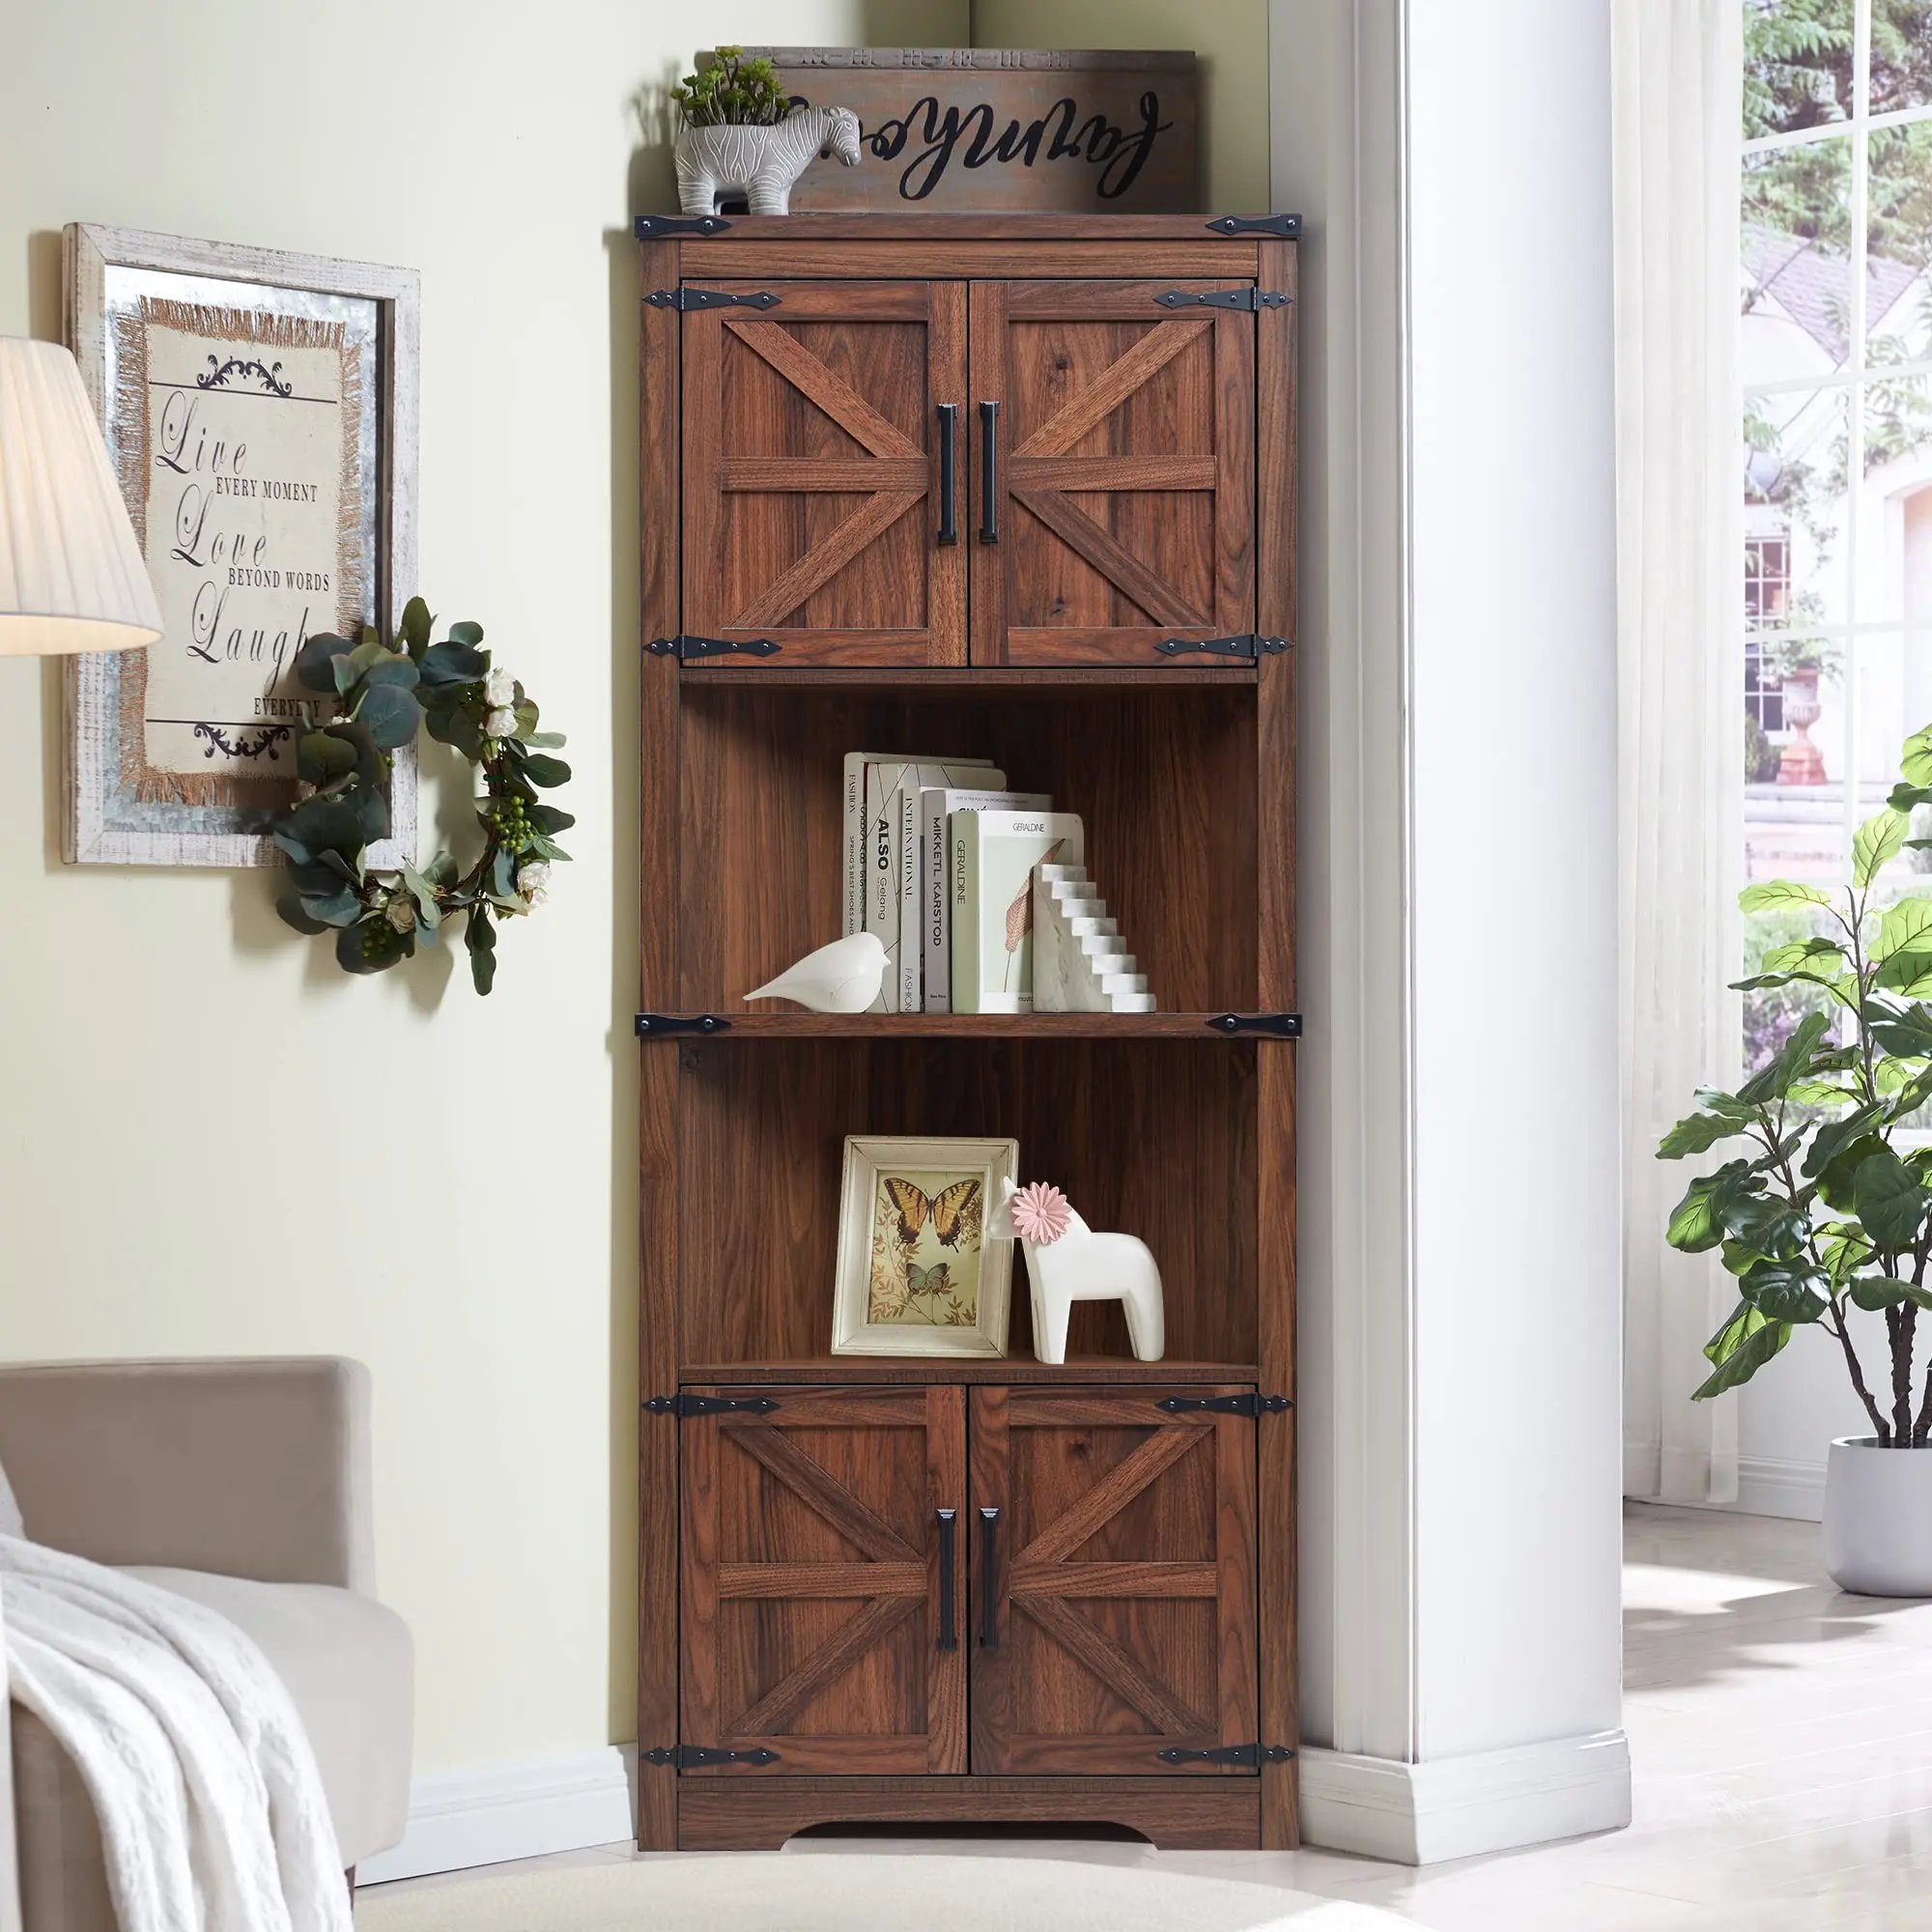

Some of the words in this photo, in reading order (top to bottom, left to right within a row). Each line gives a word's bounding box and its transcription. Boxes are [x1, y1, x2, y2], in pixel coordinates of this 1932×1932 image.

[857, 91, 1174, 200] farmho
[155, 390, 248, 474] Live
[215, 476, 258, 497] EVERY
[262, 481, 318, 502] MOMENT
[170, 483, 267, 567] Love
[228, 567, 281, 588] BEYOND
[285, 571, 330, 592] WORDS
[848, 774, 857, 813] FASHION
[877, 818, 890, 870] ALSO
[904, 798, 913, 900] INTERNATIONAL
[932, 816, 943, 877] MIKKETL
[1012, 822, 1045, 833] GERALDINE
[877, 877, 888, 921] Gelang
[956, 839, 966, 905] GERALDINE
[932, 882, 943, 947] KARSTOD
[904, 968, 913, 1011] FASHION
